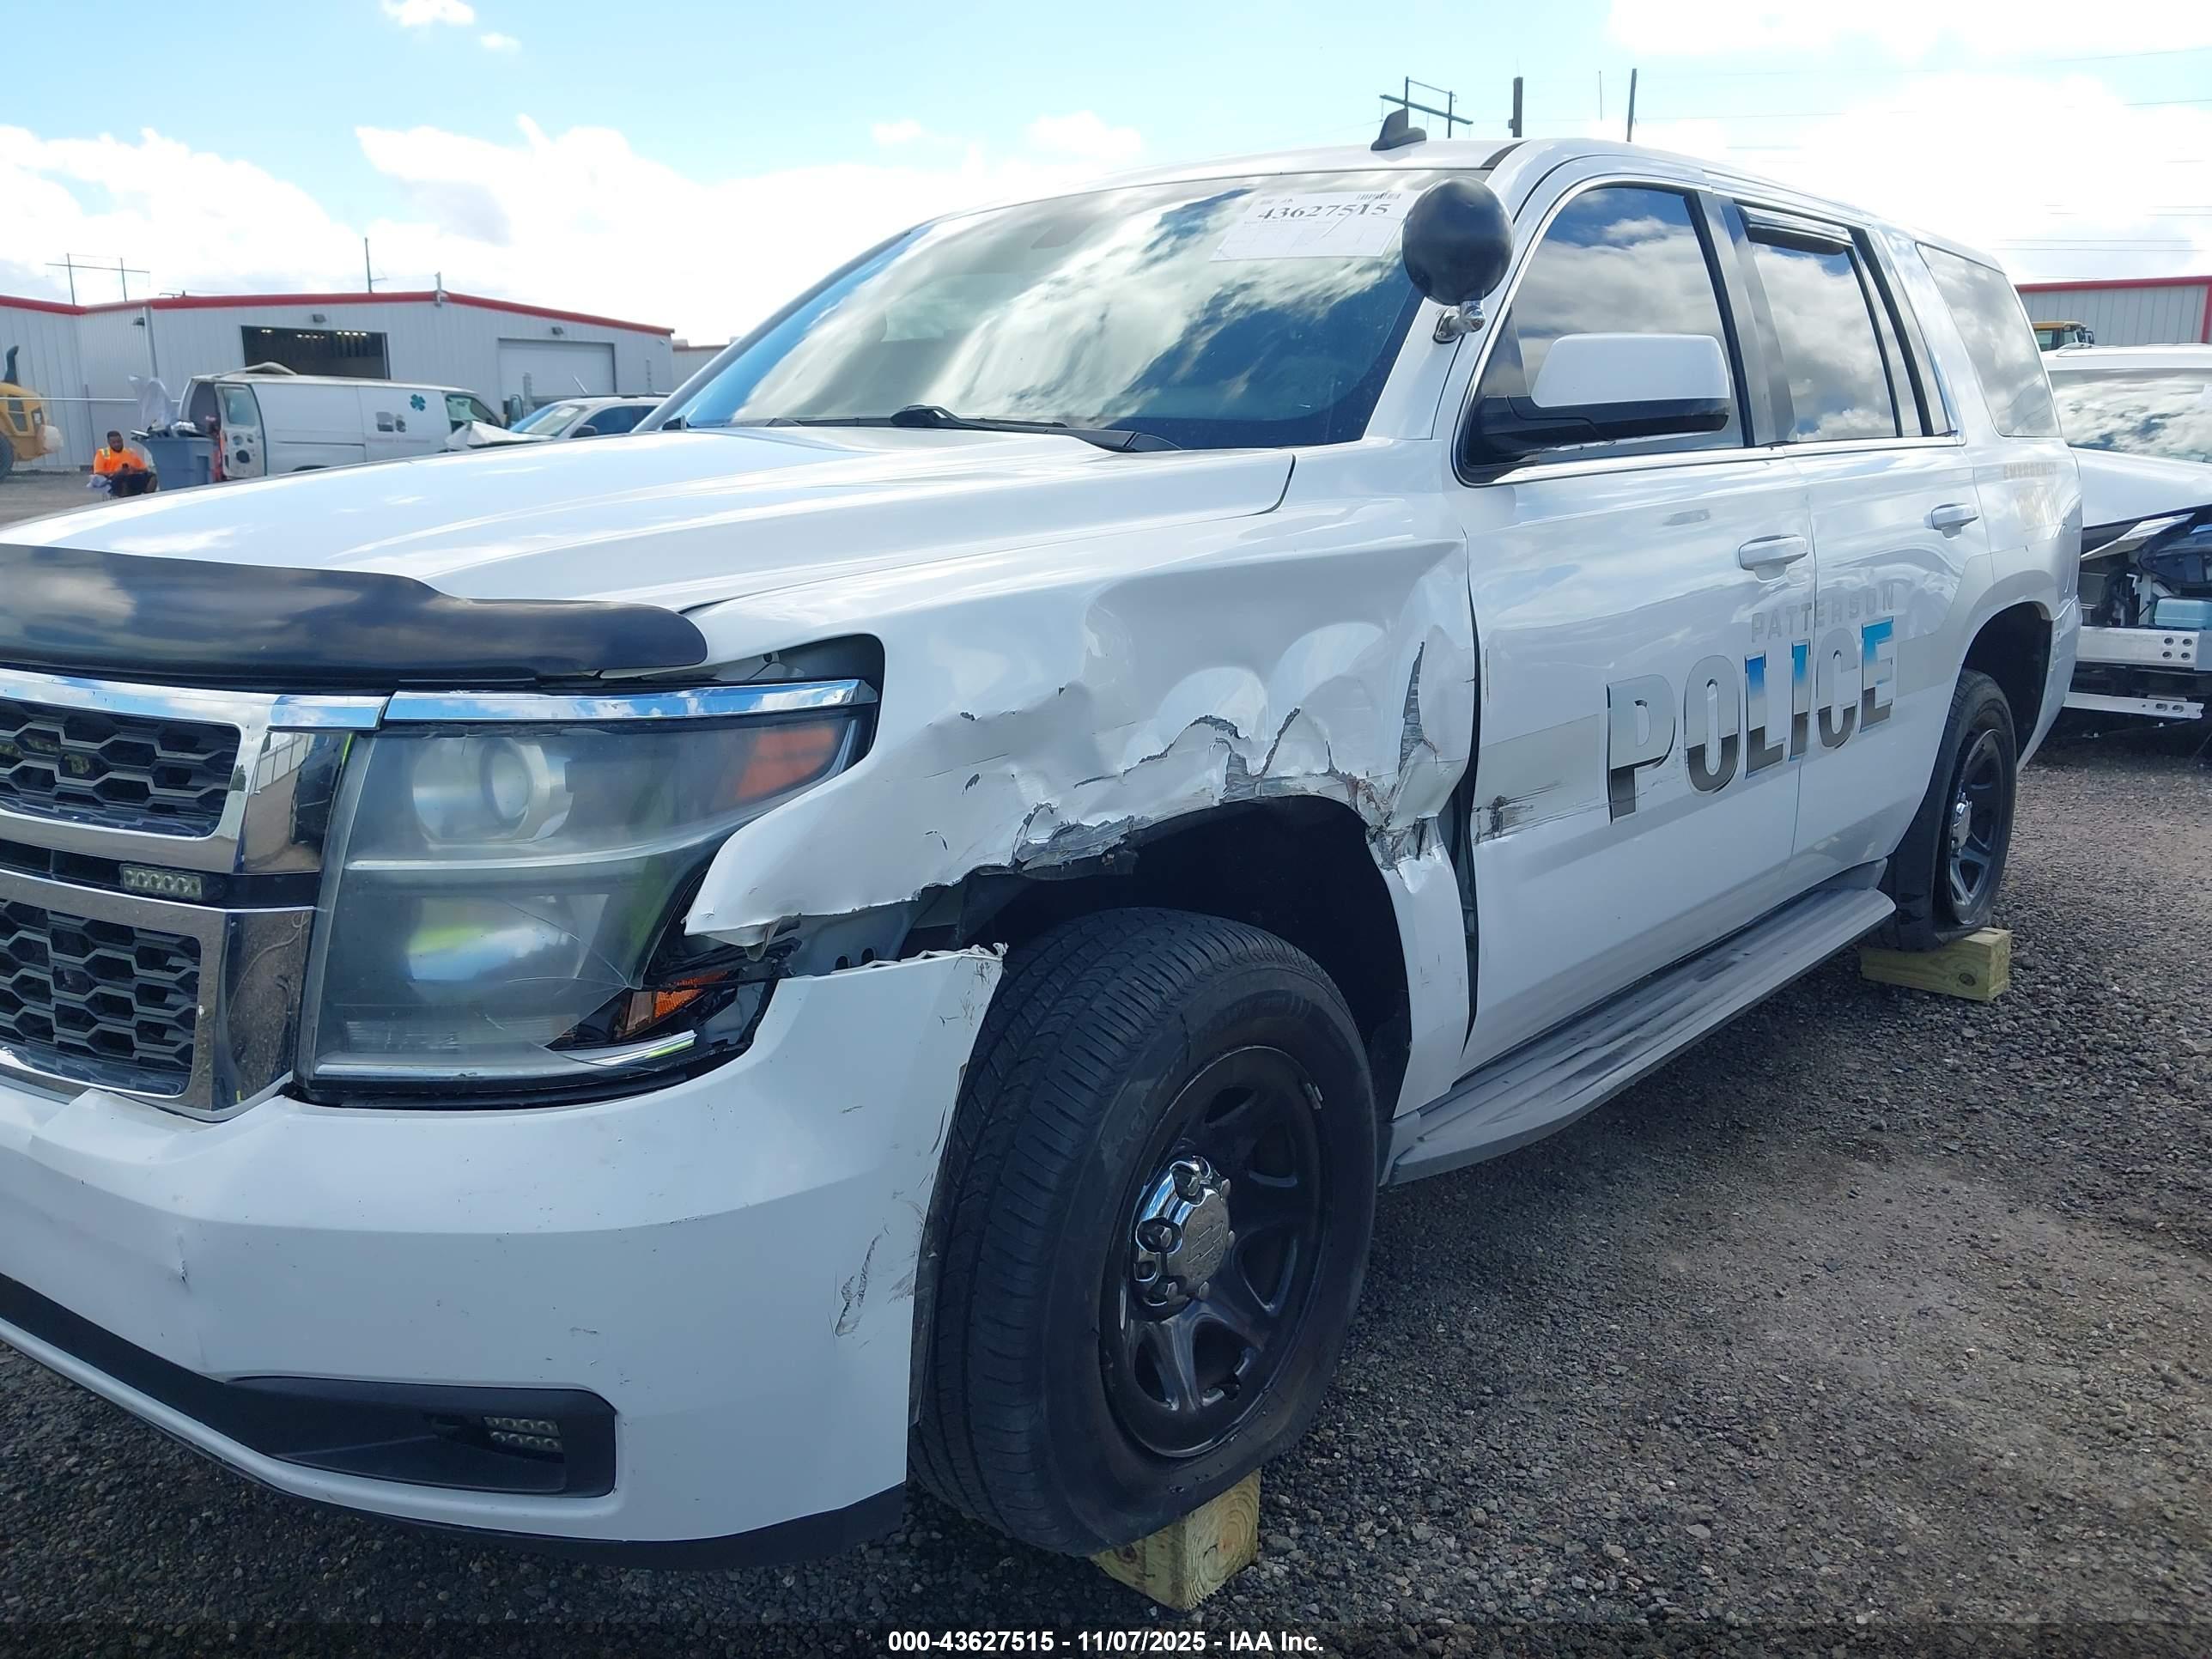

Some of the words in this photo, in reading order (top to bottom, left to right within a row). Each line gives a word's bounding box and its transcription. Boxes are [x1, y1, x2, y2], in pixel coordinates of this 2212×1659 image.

[1257, 204, 1391, 219] 43627515
[1750, 580, 1894, 643] PATTERSON
[1606, 615, 1894, 825] POLICE
